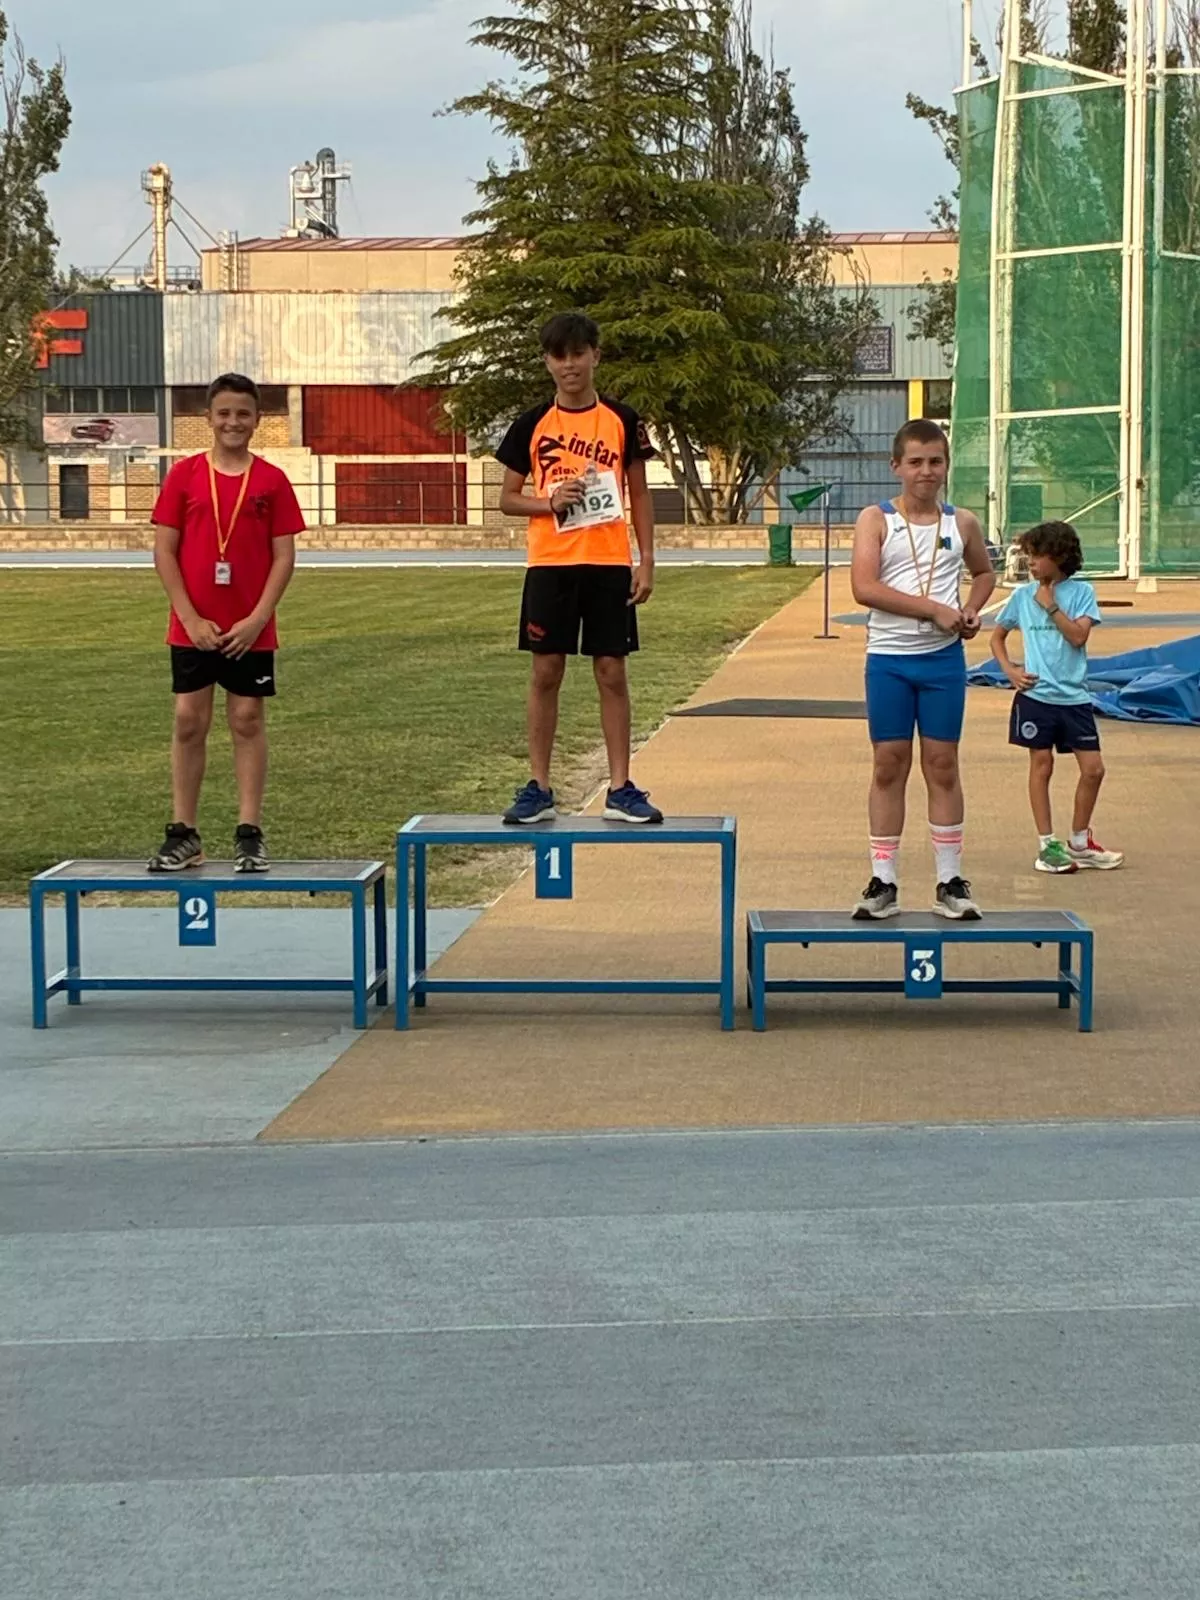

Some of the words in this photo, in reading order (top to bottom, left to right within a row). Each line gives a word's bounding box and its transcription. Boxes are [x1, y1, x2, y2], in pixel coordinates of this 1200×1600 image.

[544, 847, 561, 879] 1
[185, 897, 209, 929] 2
[911, 950, 936, 982] 3
